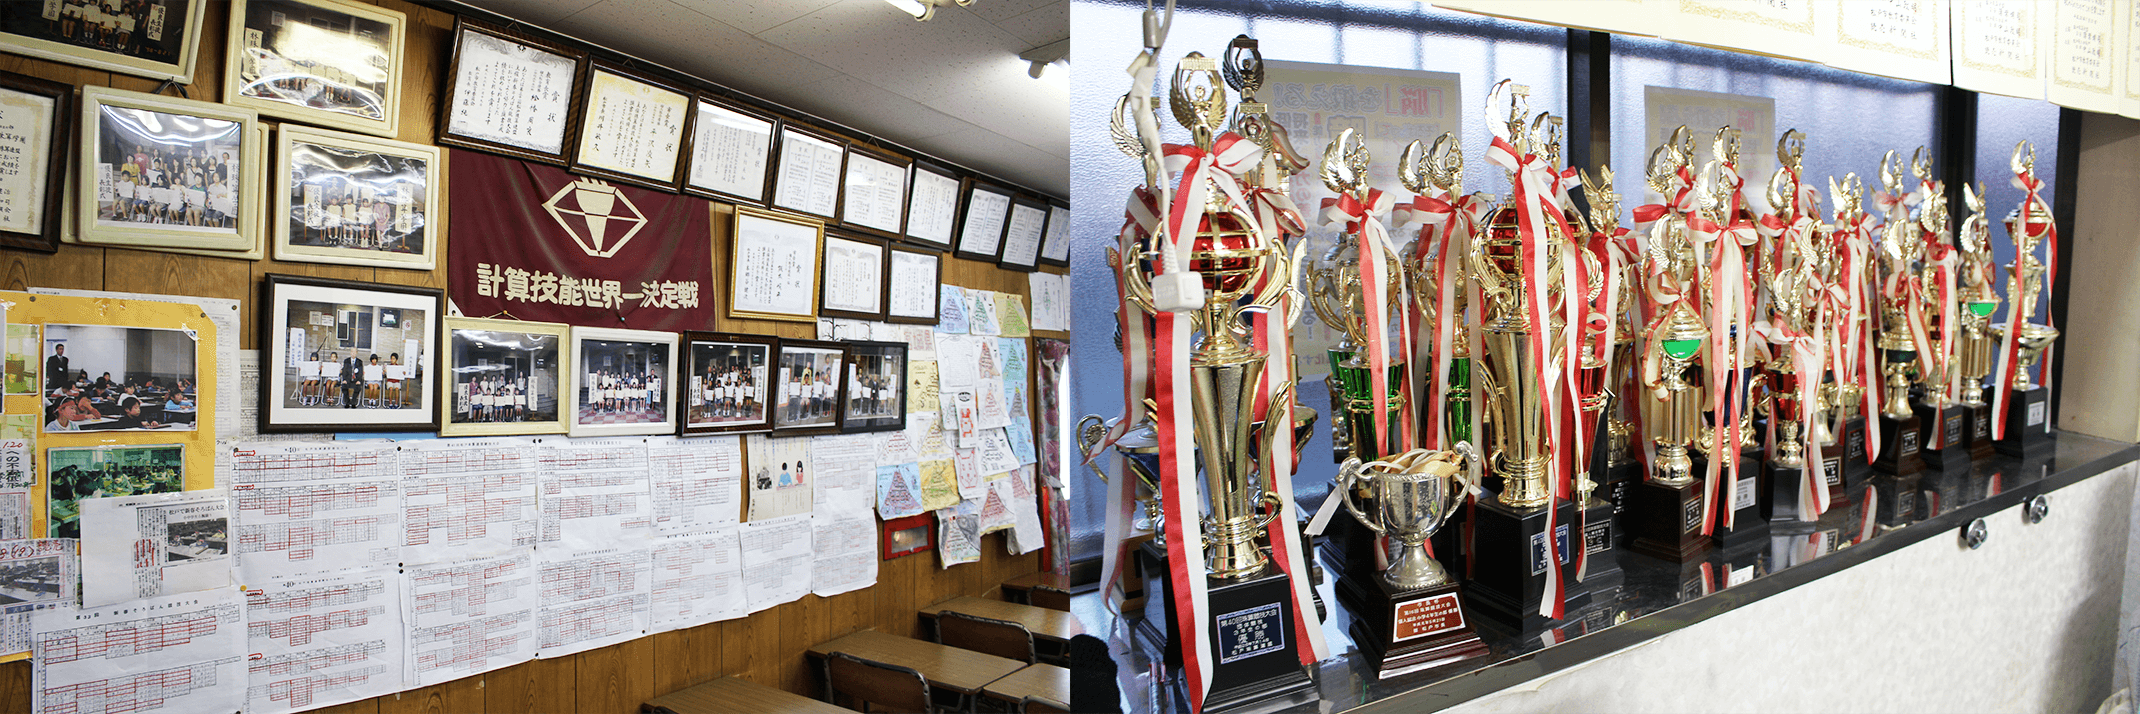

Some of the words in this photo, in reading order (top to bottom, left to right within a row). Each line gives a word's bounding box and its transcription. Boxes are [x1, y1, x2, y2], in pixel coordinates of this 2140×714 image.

[477, 262, 699, 310] 計算技能世界一決定戦
